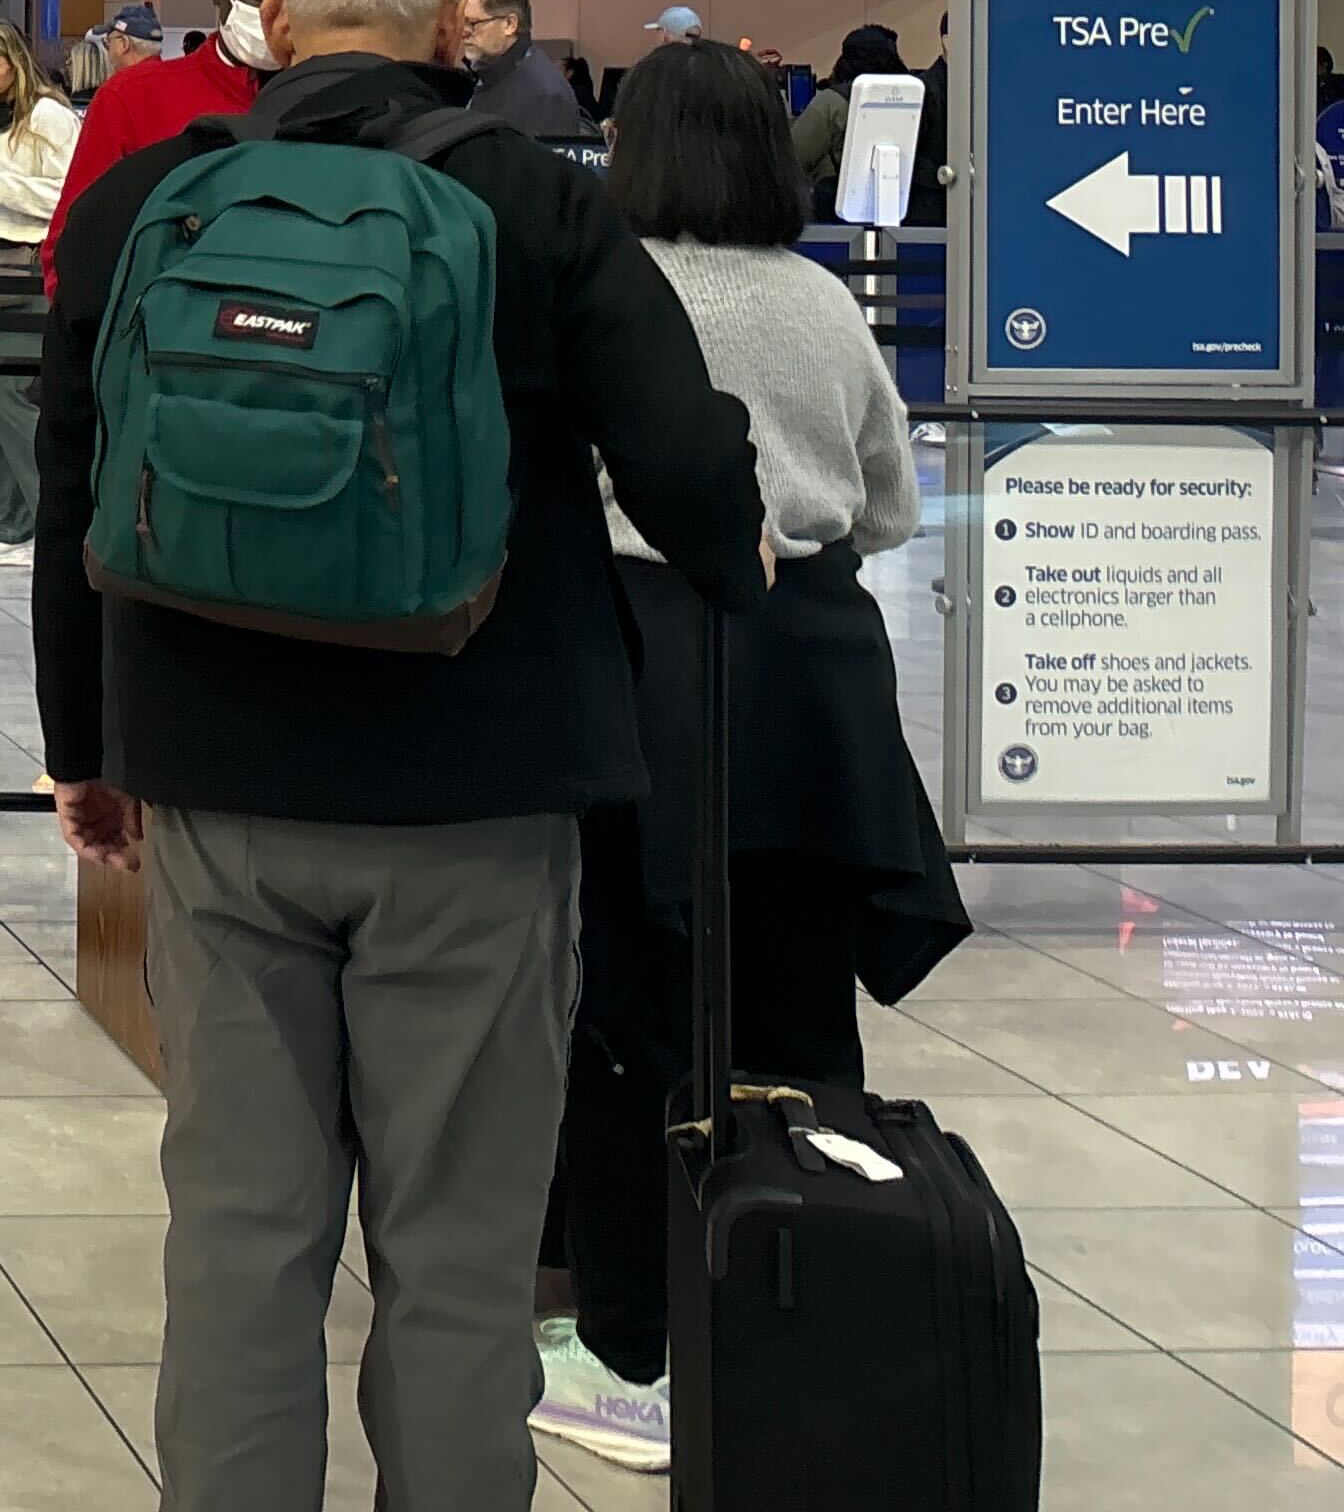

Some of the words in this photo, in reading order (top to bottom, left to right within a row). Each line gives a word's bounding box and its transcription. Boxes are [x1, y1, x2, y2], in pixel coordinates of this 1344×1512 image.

[1053, 16, 1112, 46] TSA
[1120, 17, 1169, 47] Pre
[1058, 97, 1132, 126] Enter
[1141, 99, 1206, 126] Here
[233, 313, 306, 334] EASTPAK
[1005, 477, 1064, 495] Please
[1068, 478, 1089, 495] be
[1094, 478, 1144, 498] ready
[1150, 479, 1175, 496] for
[1179, 480, 1252, 498] security:
[1025, 522, 1075, 541] Show
[1080, 523, 1098, 540] ID
[1103, 523, 1136, 541] and
[1142, 524, 1216, 543] boarding
[1221, 527, 1261, 542] pass.
[1025, 566, 1067, 583] Take
[1072, 567, 1101, 583] out
[1106, 566, 1162, 586] liquids
[1167, 566, 1199, 584] and
[1203, 567, 1222, 584] all
[1025, 588, 1119, 605] electronics
[1124, 589, 1173, 609] larger
[1178, 589, 1216, 606] than
[1025, 612, 1036, 627] a
[1040, 610, 1128, 631] cellphone.
[1025, 654, 1067, 670] Take
[1072, 654, 1097, 671] off
[1101, 654, 1150, 671] shoes
[1154, 654, 1185, 671] and
[1190, 654, 1253, 674] jackets.
[1025, 675, 1058, 693] You
[1063, 678, 1101, 697] may
[1107, 676, 1129, 693] be
[1132, 676, 1183, 693] asked
[1187, 677, 1204, 693] to
[1025, 700, 1092, 715] remove
[1097, 698, 1183, 715] additional
[1187, 698, 1233, 715] items
[1025, 720, 1067, 737] from
[1073, 723, 1113, 739] your
[1118, 720, 1153, 740] bag.
[595, 1394, 663, 1425] HOKA
